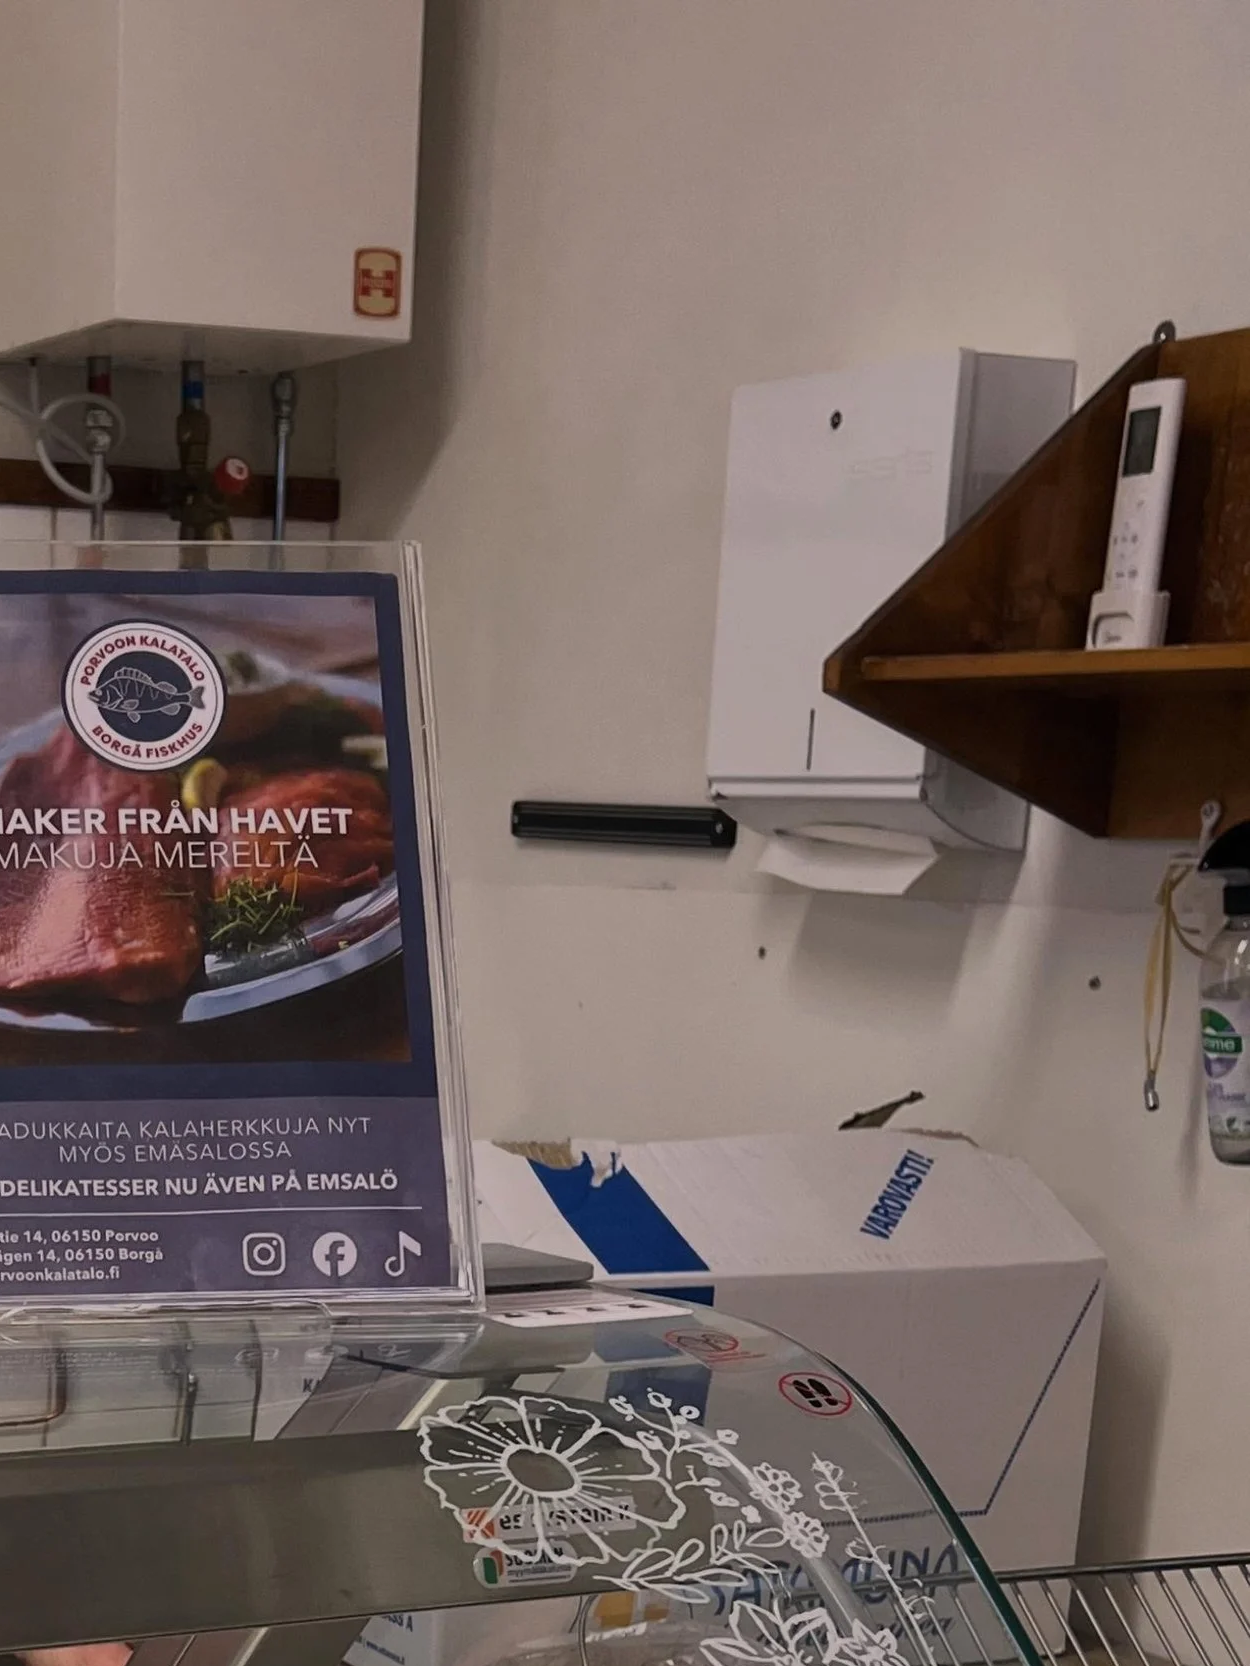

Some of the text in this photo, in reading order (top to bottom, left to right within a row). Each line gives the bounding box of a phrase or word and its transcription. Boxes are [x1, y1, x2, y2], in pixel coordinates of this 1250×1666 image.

[81, 634, 205, 686] PORVOON KALATALO
[92, 721, 204, 760] BORGÅ FISKHUS
[118, 800, 219, 835] FRÅN
[230, 807, 353, 835] HAVET
[154, 833, 319, 869] MERELTÄ
[139, 1117, 320, 1140] KALAHERKKUJA
[328, 1116, 372, 1135] NYT
[59, 1138, 293, 1164] MYÖS EMÄSALOSSA
[164, 1176, 199, 1196] NU
[203, 1170, 266, 1195] ÄVEN
[271, 1169, 302, 1192] PÅ
[307, 1168, 399, 1191] EMSALÖ
[860, 1148, 934, 1240] VAROVASTI!
[23, 1230, 48, 1245] 14,
[51, 1229, 101, 1243] 06150
[106, 1229, 159, 1243] Porvoo
[37, 1248, 61, 1264] 14,
[64, 1247, 115, 1262] 06150
[118, 1246, 164, 1264] Borgå
